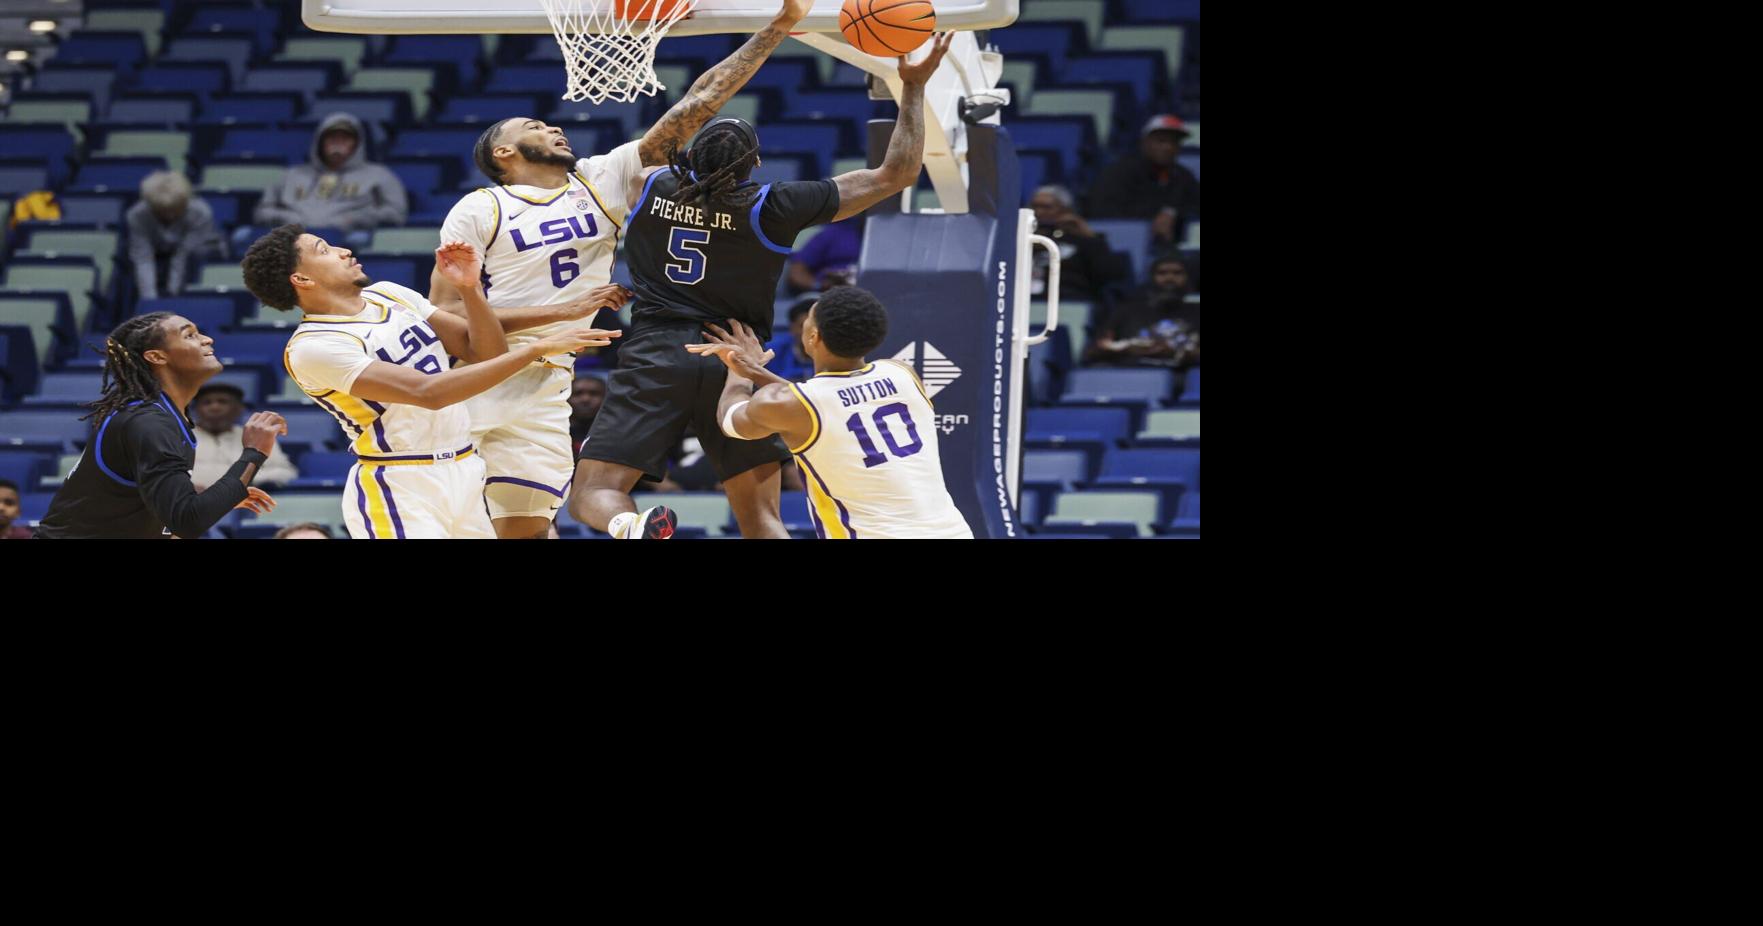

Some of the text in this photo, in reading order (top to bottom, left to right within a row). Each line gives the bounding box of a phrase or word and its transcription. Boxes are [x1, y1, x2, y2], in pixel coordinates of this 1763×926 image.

[509, 213, 599, 252] LSU
[650, 196, 736, 231] PIERRE JR.
[550, 248, 580, 288] 6
[665, 226, 711, 285] 5
[837, 377, 898, 407] SUTTON
[993, 261, 1016, 537] NEWAGEPRODUCTS.COM
[846, 402, 923, 468] 10
[436, 451, 454, 460] LSU
